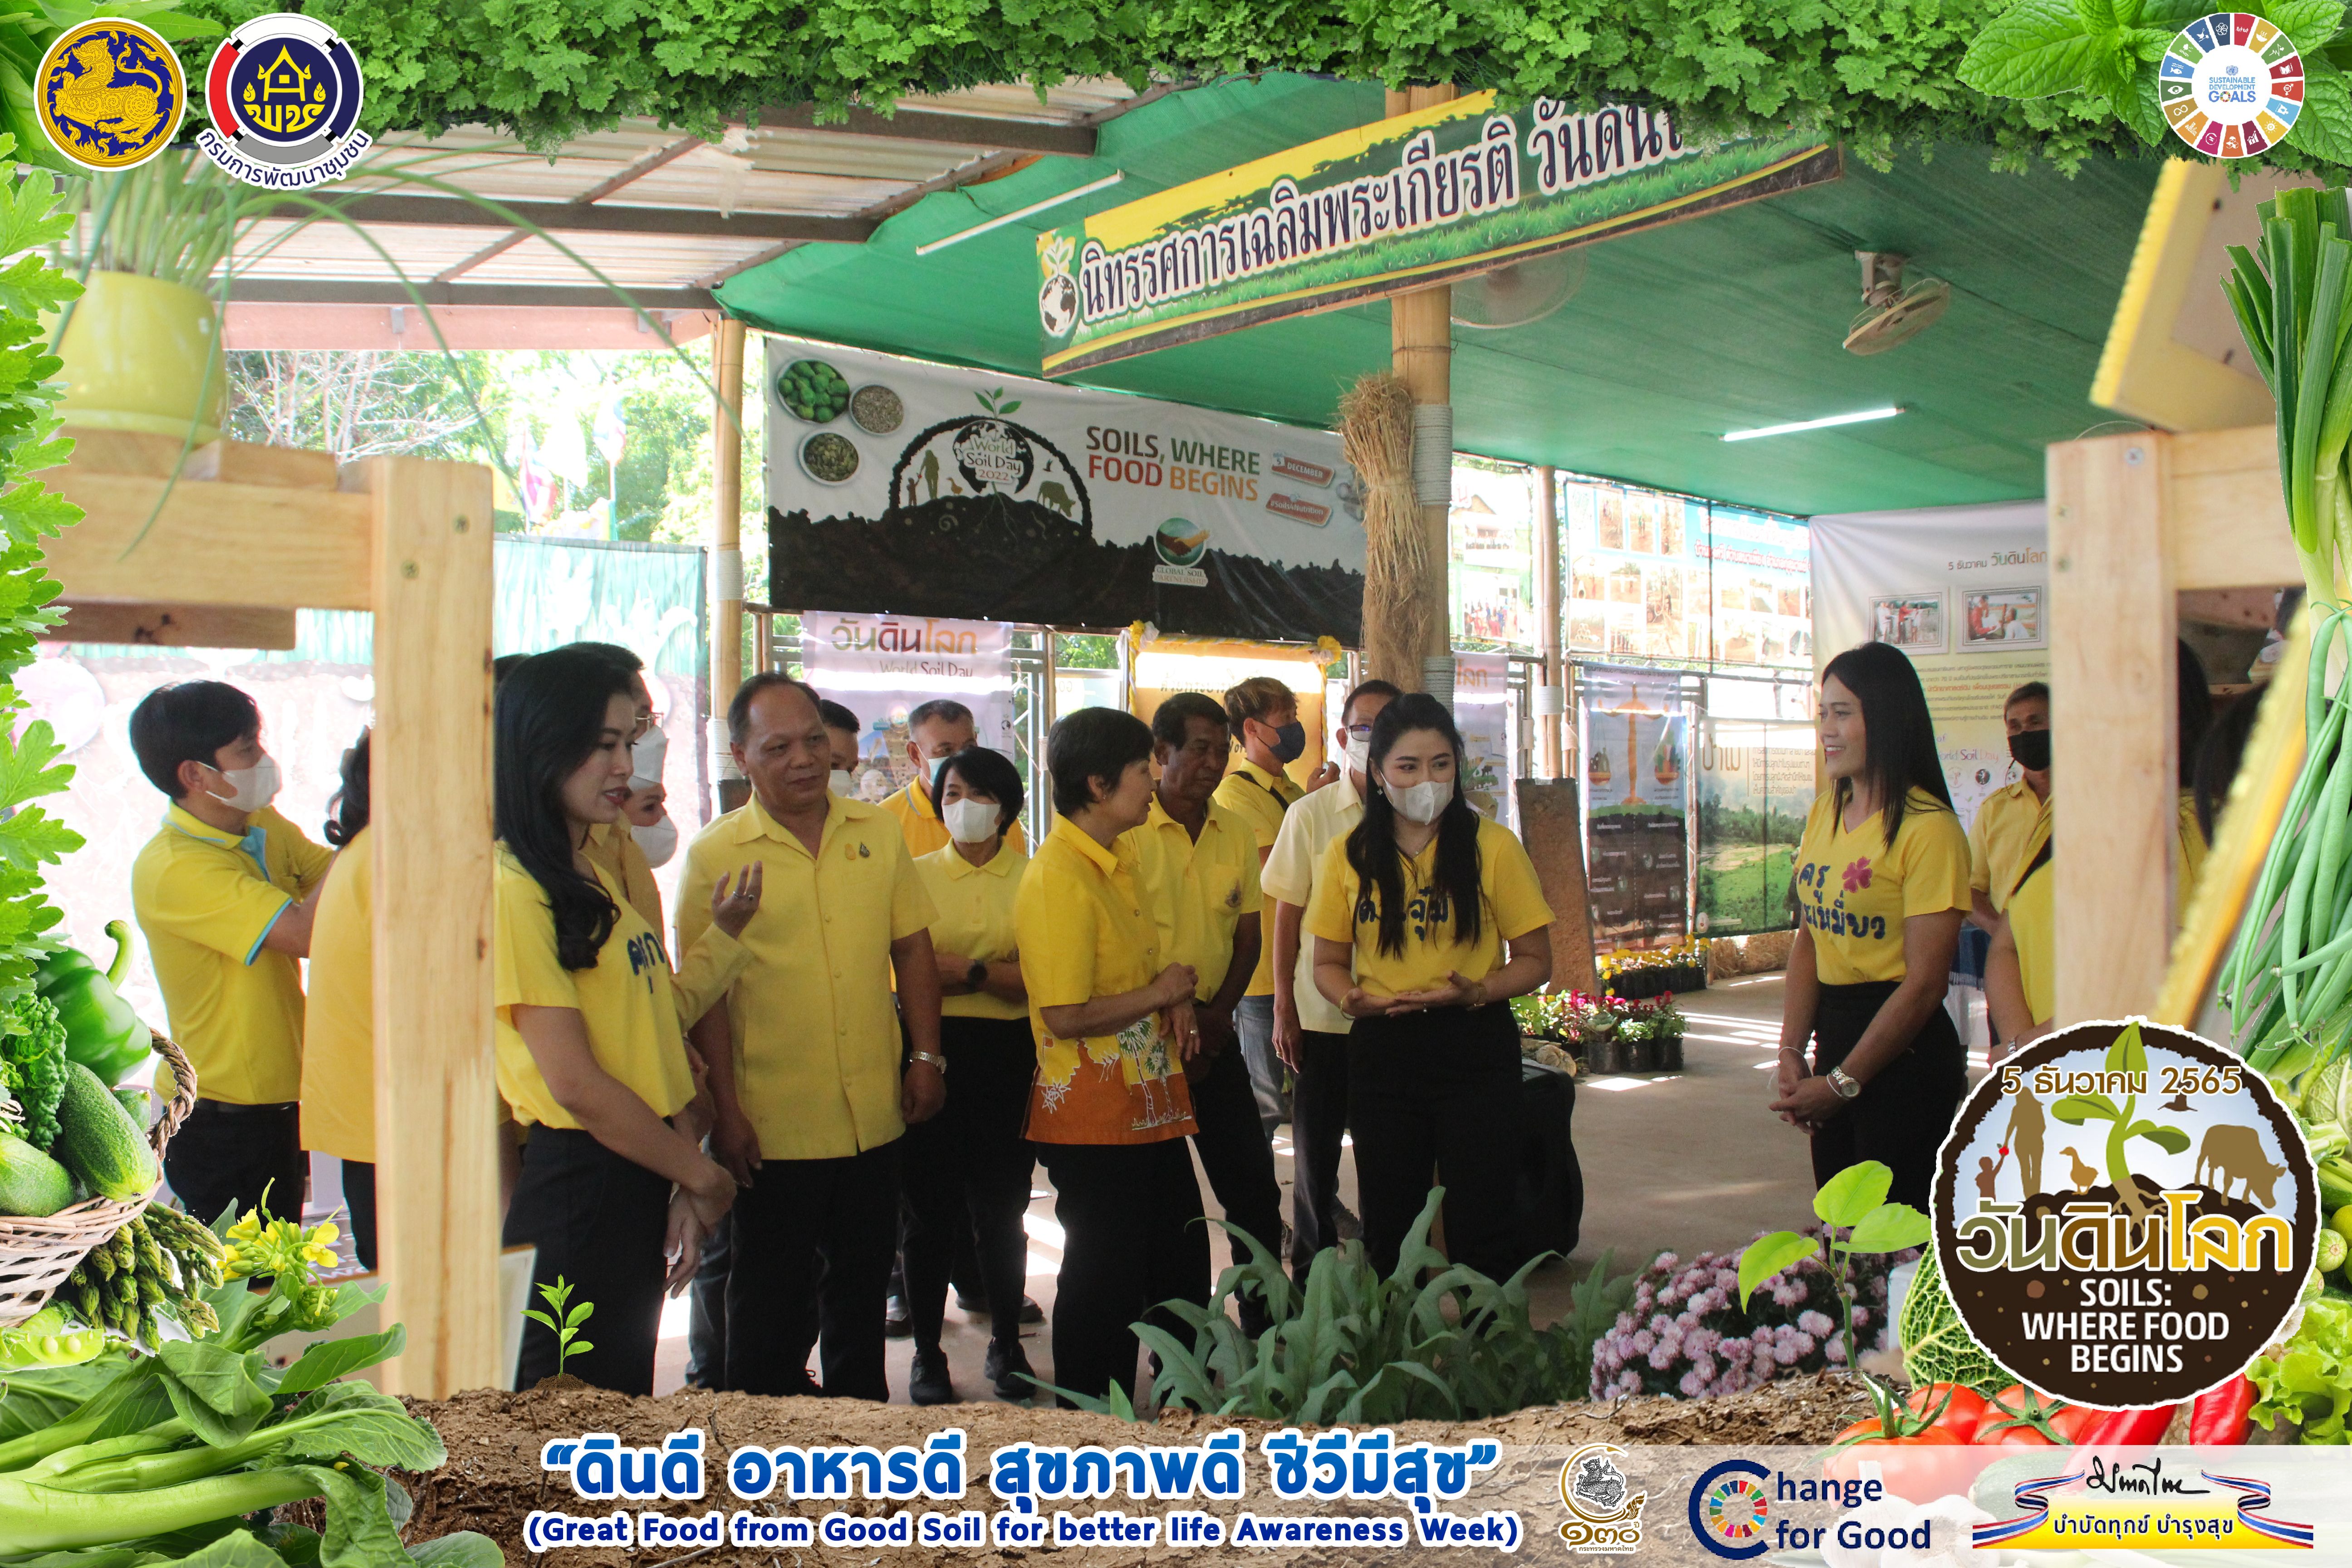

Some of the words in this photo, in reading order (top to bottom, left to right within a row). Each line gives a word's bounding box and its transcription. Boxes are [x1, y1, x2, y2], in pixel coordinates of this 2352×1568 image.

[974, 437, 1013, 454] World
[1087, 426, 1165, 464] SOILS,
[1171, 437, 1260, 475] WHERE
[966, 452, 992, 467] Soil
[995, 456, 1020, 475] Day
[1287, 462, 1323, 478] DECEMBER
[979, 469, 1009, 480] 2022
[1088, 455, 1163, 486] FOOD
[1170, 466, 1258, 501] BEGINS
[1948, 562, 1954, 570] 5
[1957, 560, 1987, 570] ธันวาคม
[1991, 547, 2048, 566] วันดินโลก
[1156, 567, 1185, 575] GLOBAL
[831, 617, 977, 654] วันดินโลก
[879, 660, 917, 675] World
[921, 661, 945, 676] Soil
[1936, 733, 1946, 742] of
[1939, 750, 1959, 760] orld
[1960, 749, 1978, 760] Soil
[1980, 750, 1999, 764] Day
[1798, 862, 1831, 905] ครู
